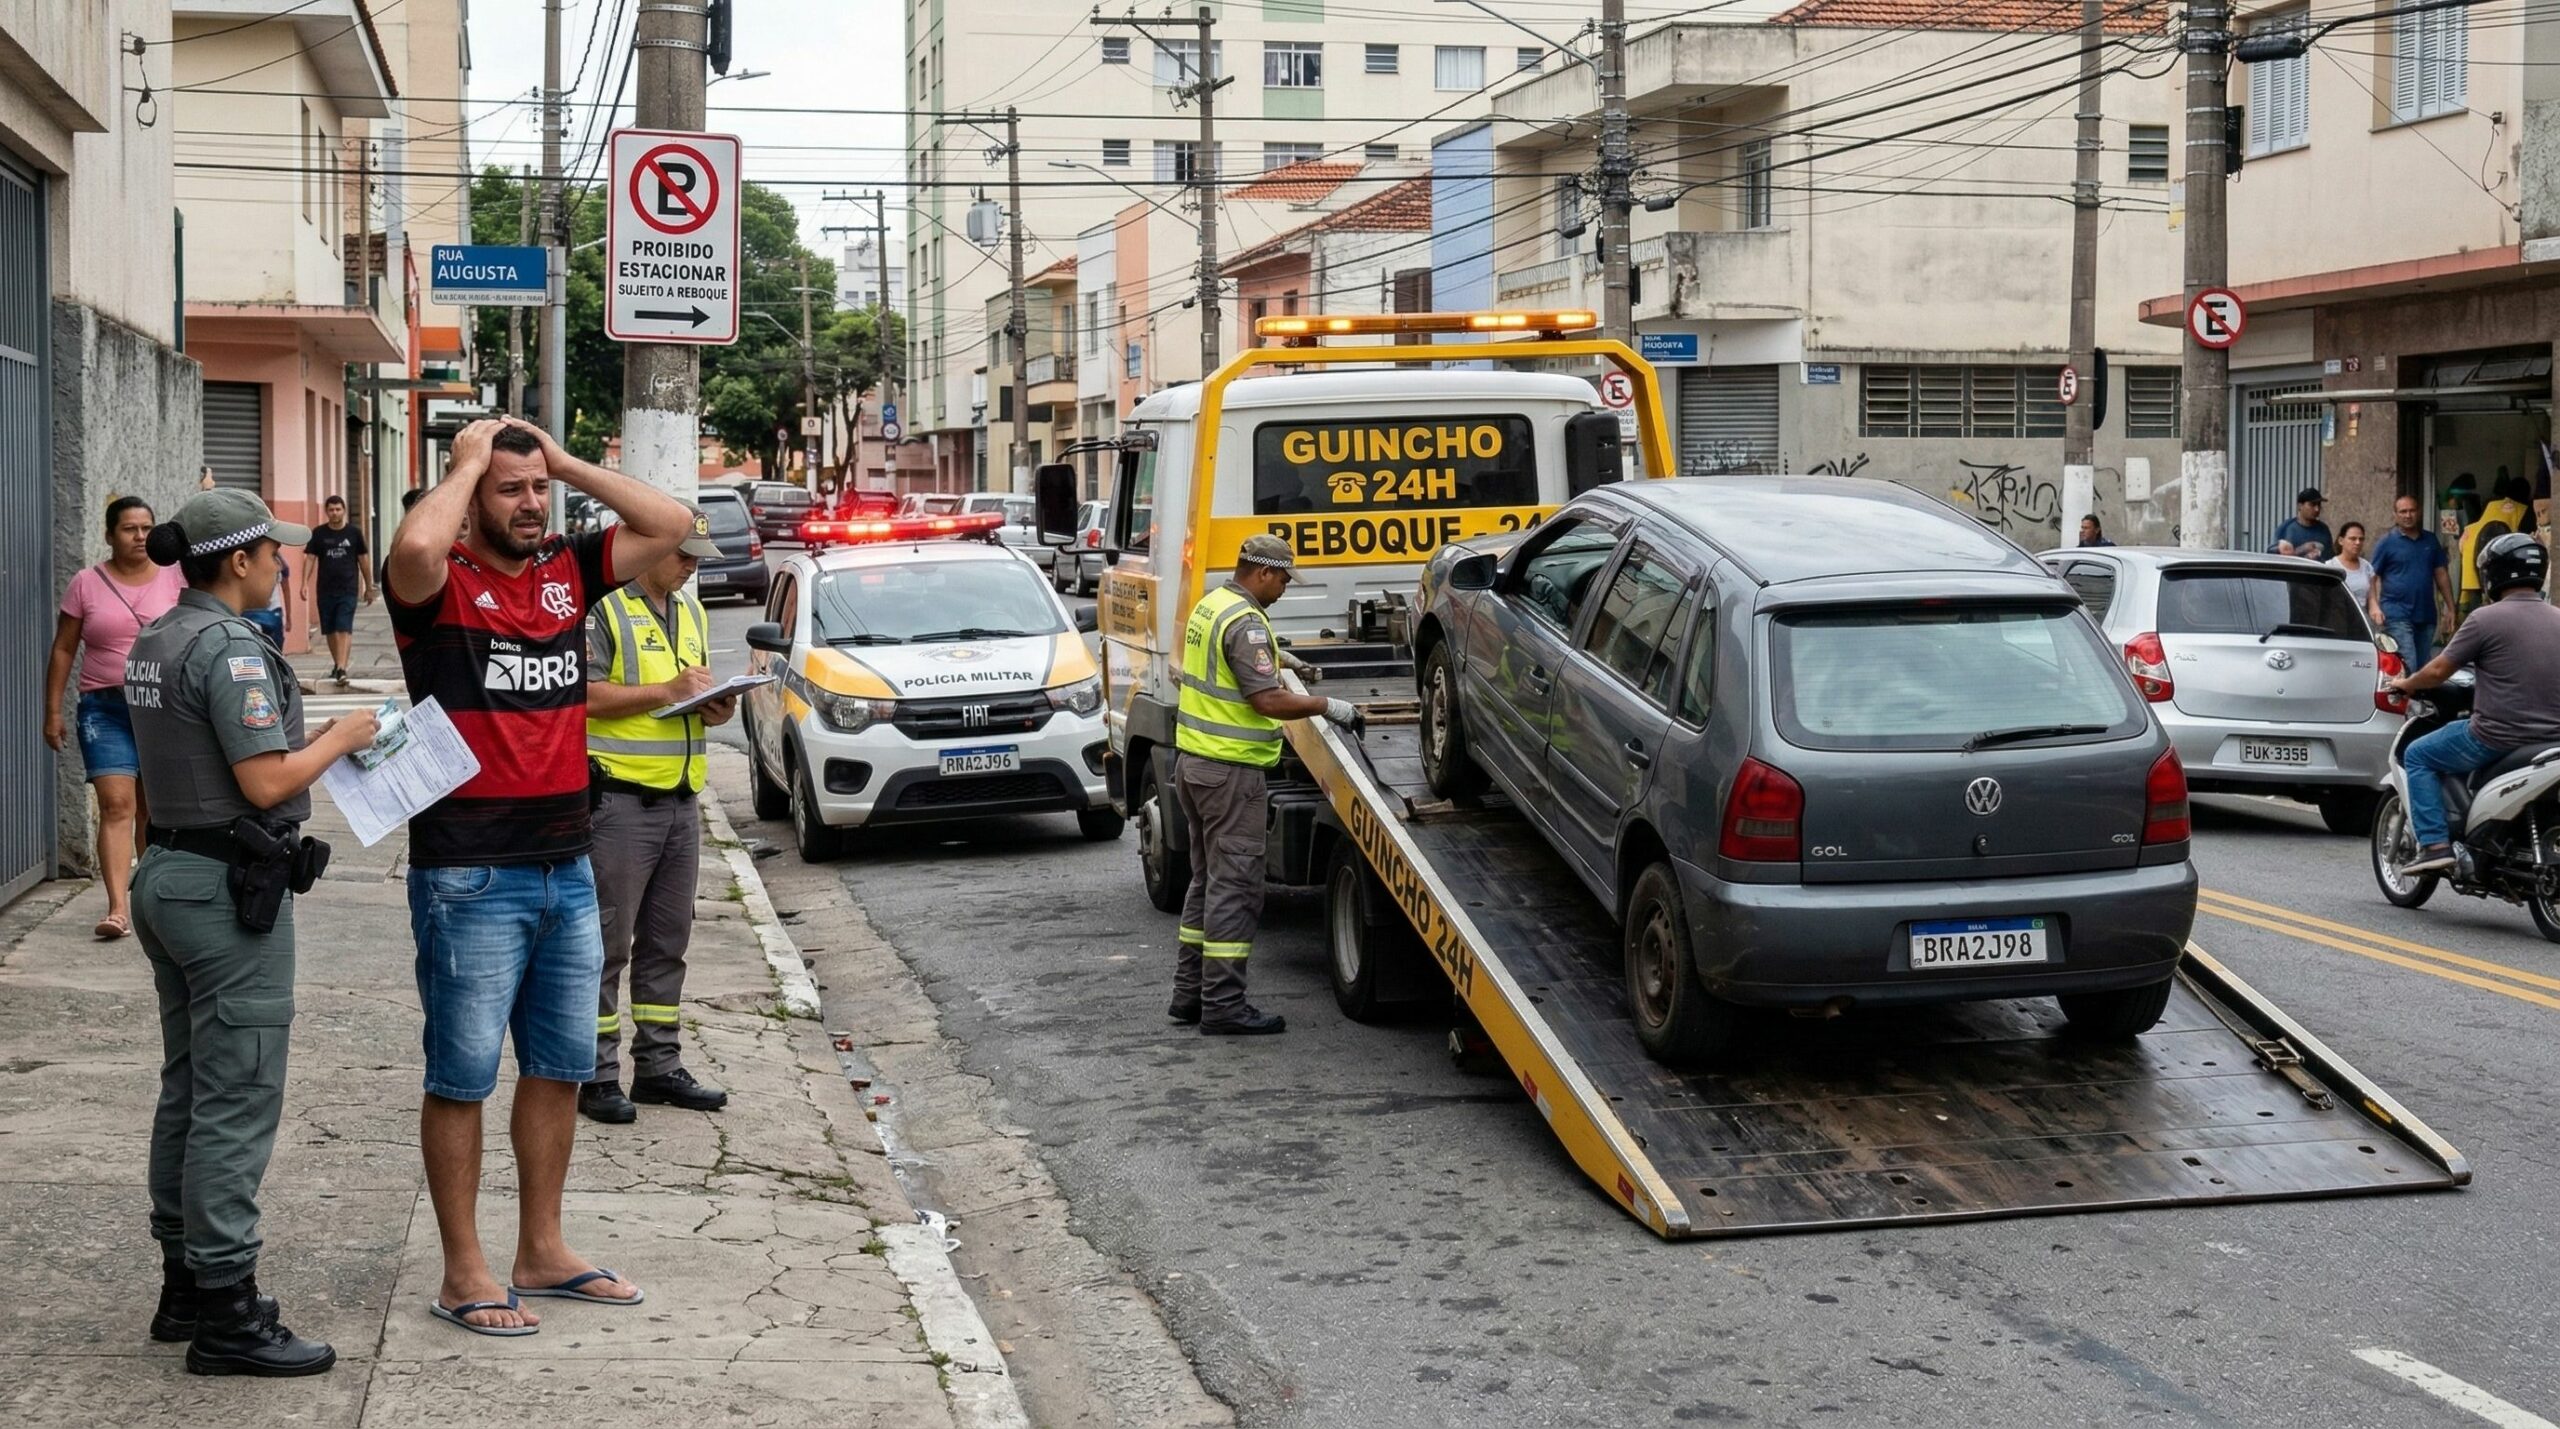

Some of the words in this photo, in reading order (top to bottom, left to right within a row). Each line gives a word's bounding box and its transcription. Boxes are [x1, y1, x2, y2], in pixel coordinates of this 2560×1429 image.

[438, 249, 464, 261] RUA
[632, 240, 714, 260] PROIBIDO
[437, 265, 518, 281] AUGUSTA
[619, 261, 726, 282] ESTACIONAR
[618, 284, 664, 297] SUJEITO
[666, 286, 675, 298] A
[677, 287, 728, 301] REBOQUE
[1283, 425, 1503, 465] GUINCHO
[1372, 468, 1457, 502] 24H
[524, 650, 580, 691] BRB
[904, 673, 967, 689] POLÍCIA
[970, 671, 1034, 682] MILITAR
[962, 705, 990, 728] FIAT
[1811, 846, 1848, 858] GOL
[1350, 796, 1431, 934] GUINCHO
[1434, 915, 1475, 998] 24H
[1923, 932, 2033, 963] BRA2J98
